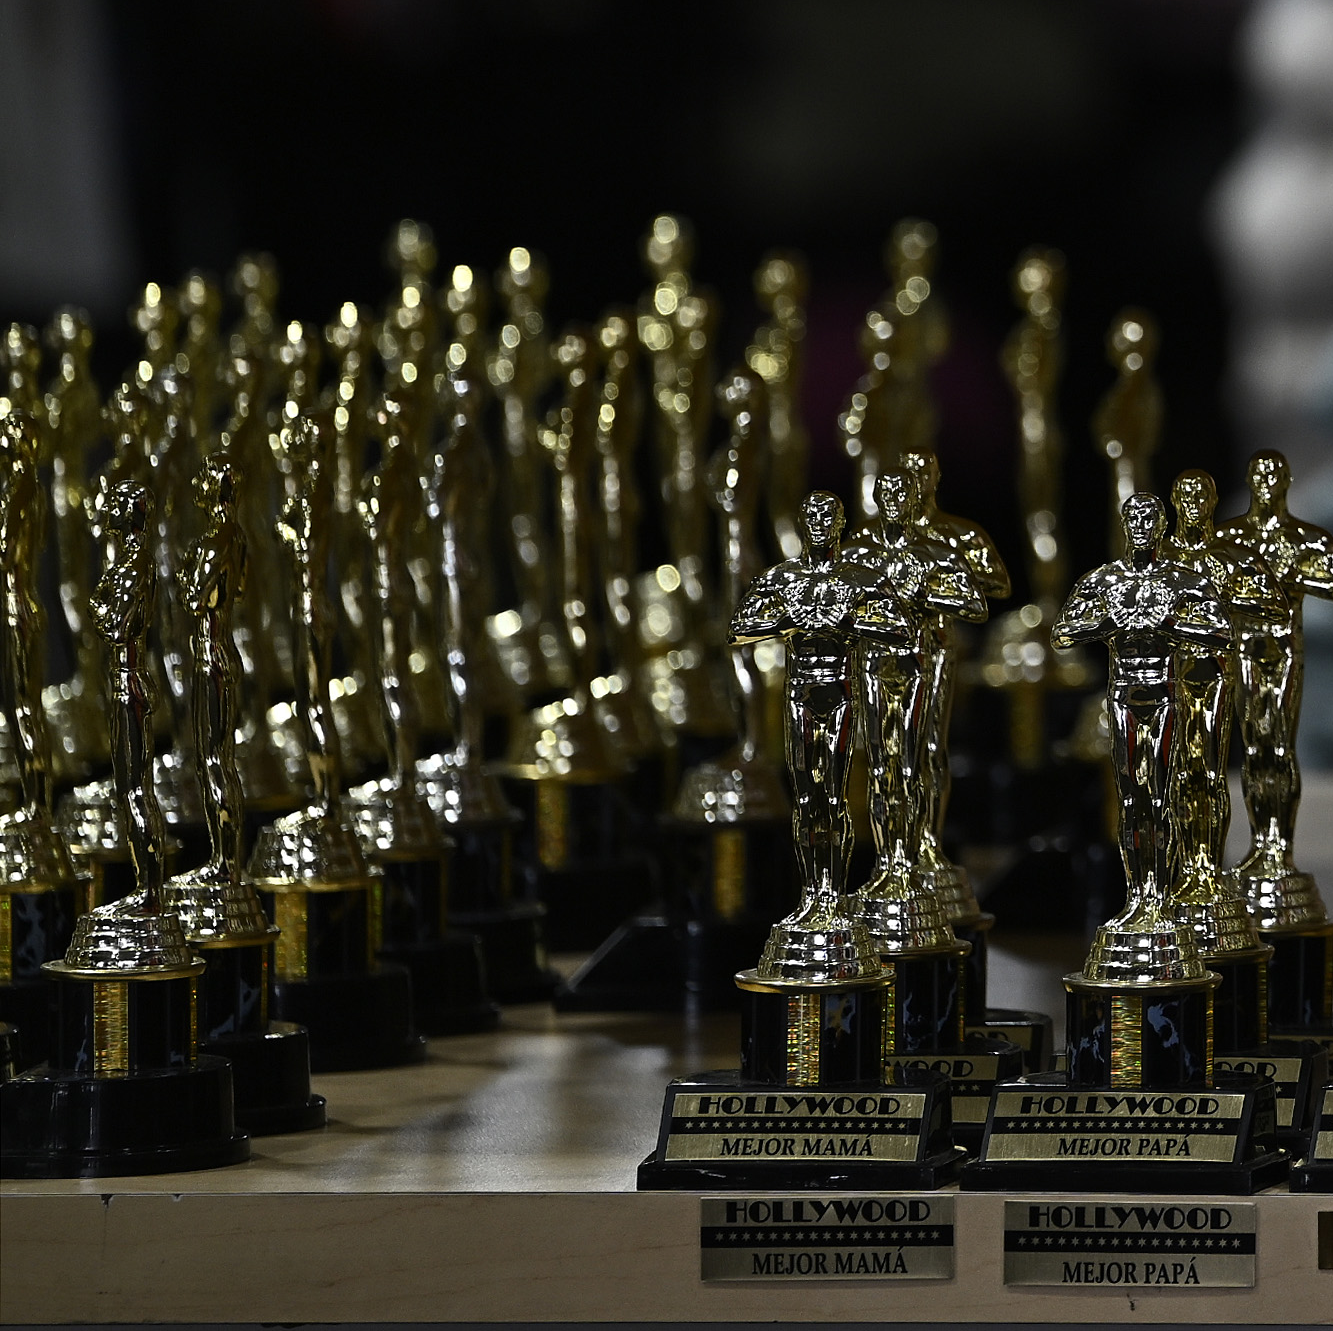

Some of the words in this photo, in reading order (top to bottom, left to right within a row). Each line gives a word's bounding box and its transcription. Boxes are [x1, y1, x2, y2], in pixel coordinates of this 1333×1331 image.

[698, 1096, 901, 1115] HOLLYWOOD
[1020, 1095, 1219, 1115] HOLLYWOOD
[721, 1137, 796, 1157] MEJOR
[801, 1132, 874, 1157] MAMÁ
[1057, 1137, 1134, 1157] MEJOR
[1139, 1132, 1191, 1157] PAPÁ
[726, 1200, 930, 1223] HOLLYWOOD
[1029, 1205, 1232, 1230] HOLLYWOOD
[752, 1252, 829, 1275] MEJOR
[834, 1246, 907, 1275] MAMÁ
[1062, 1262, 1140, 1284] MEJOR
[1144, 1256, 1200, 1284] PAPÁ
